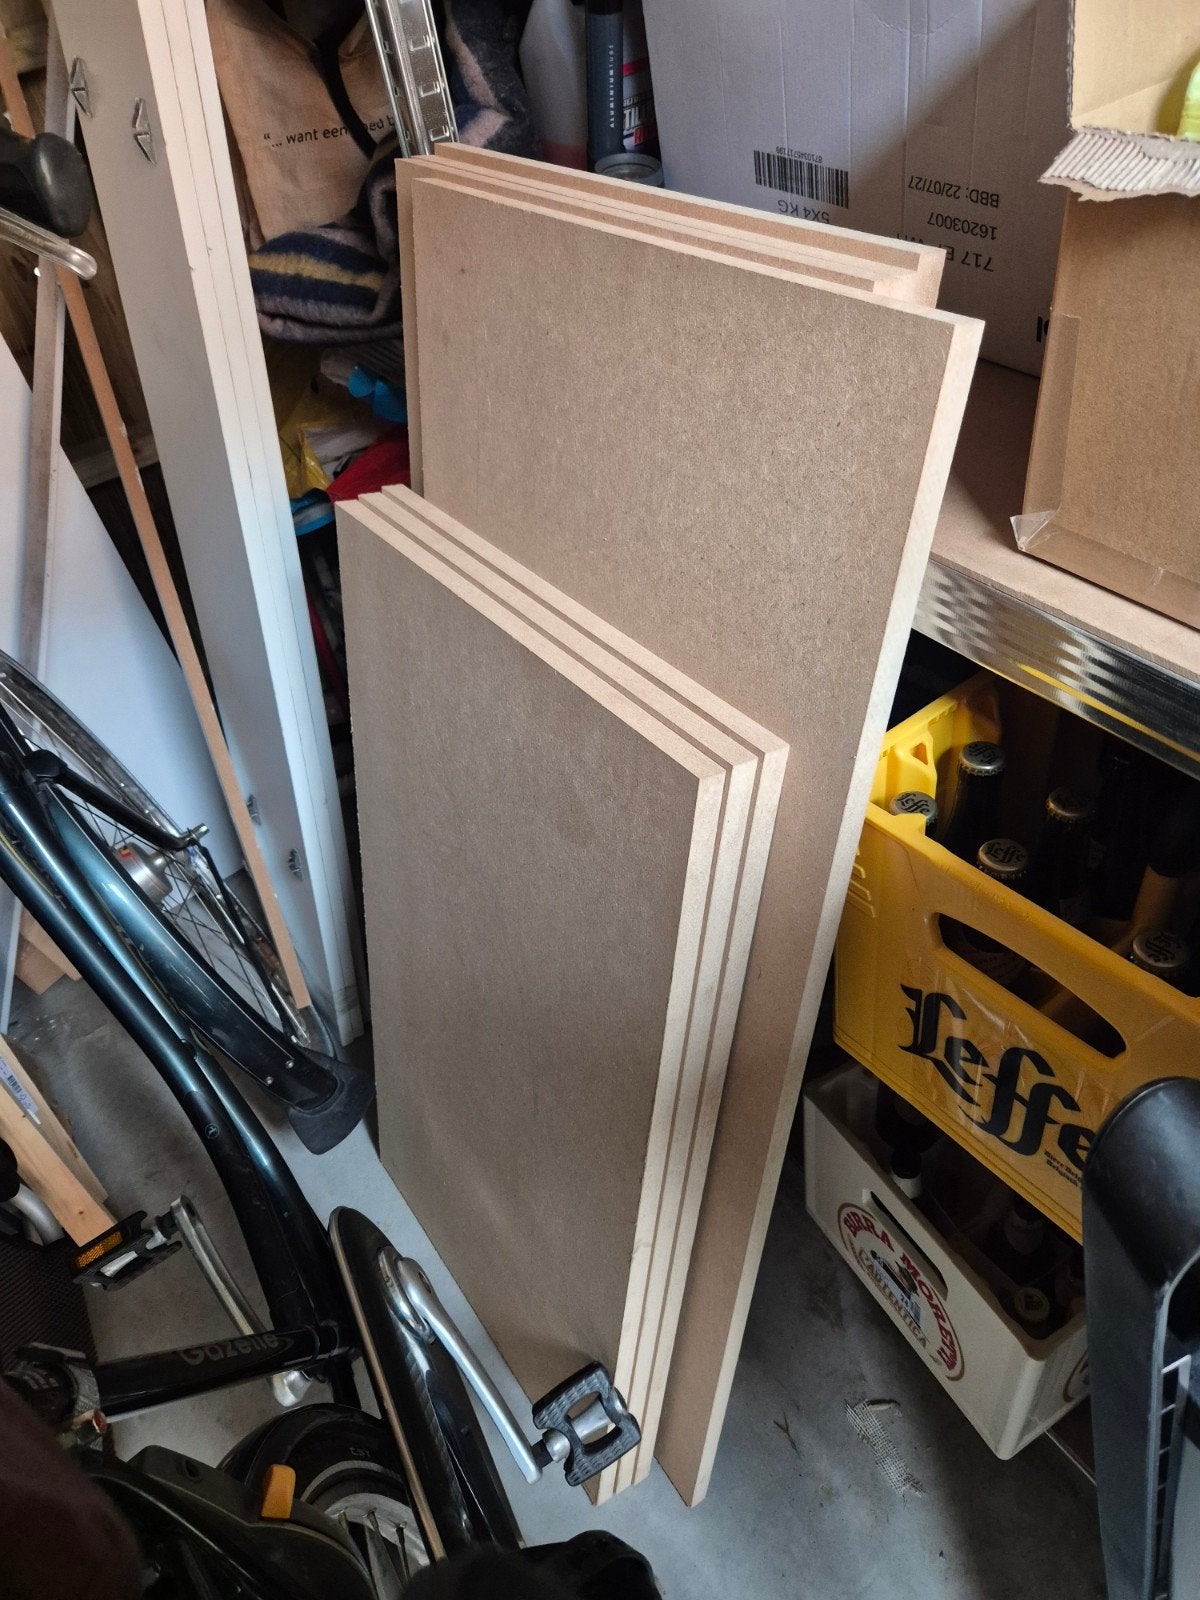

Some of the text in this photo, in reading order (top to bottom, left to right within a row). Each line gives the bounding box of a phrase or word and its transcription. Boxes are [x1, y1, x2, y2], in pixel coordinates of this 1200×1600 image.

[286, 129, 318, 145] want
[907, 175, 1000, 209] BBD: 22/07/27
[777, 199, 799, 217] KG
[927, 211, 998, 241] 16203007
[960, 250, 994, 273] 717
[843, 1211, 958, 1372] BIRRA MORETTI
[180, 1333, 279, 1366] Gazelle
